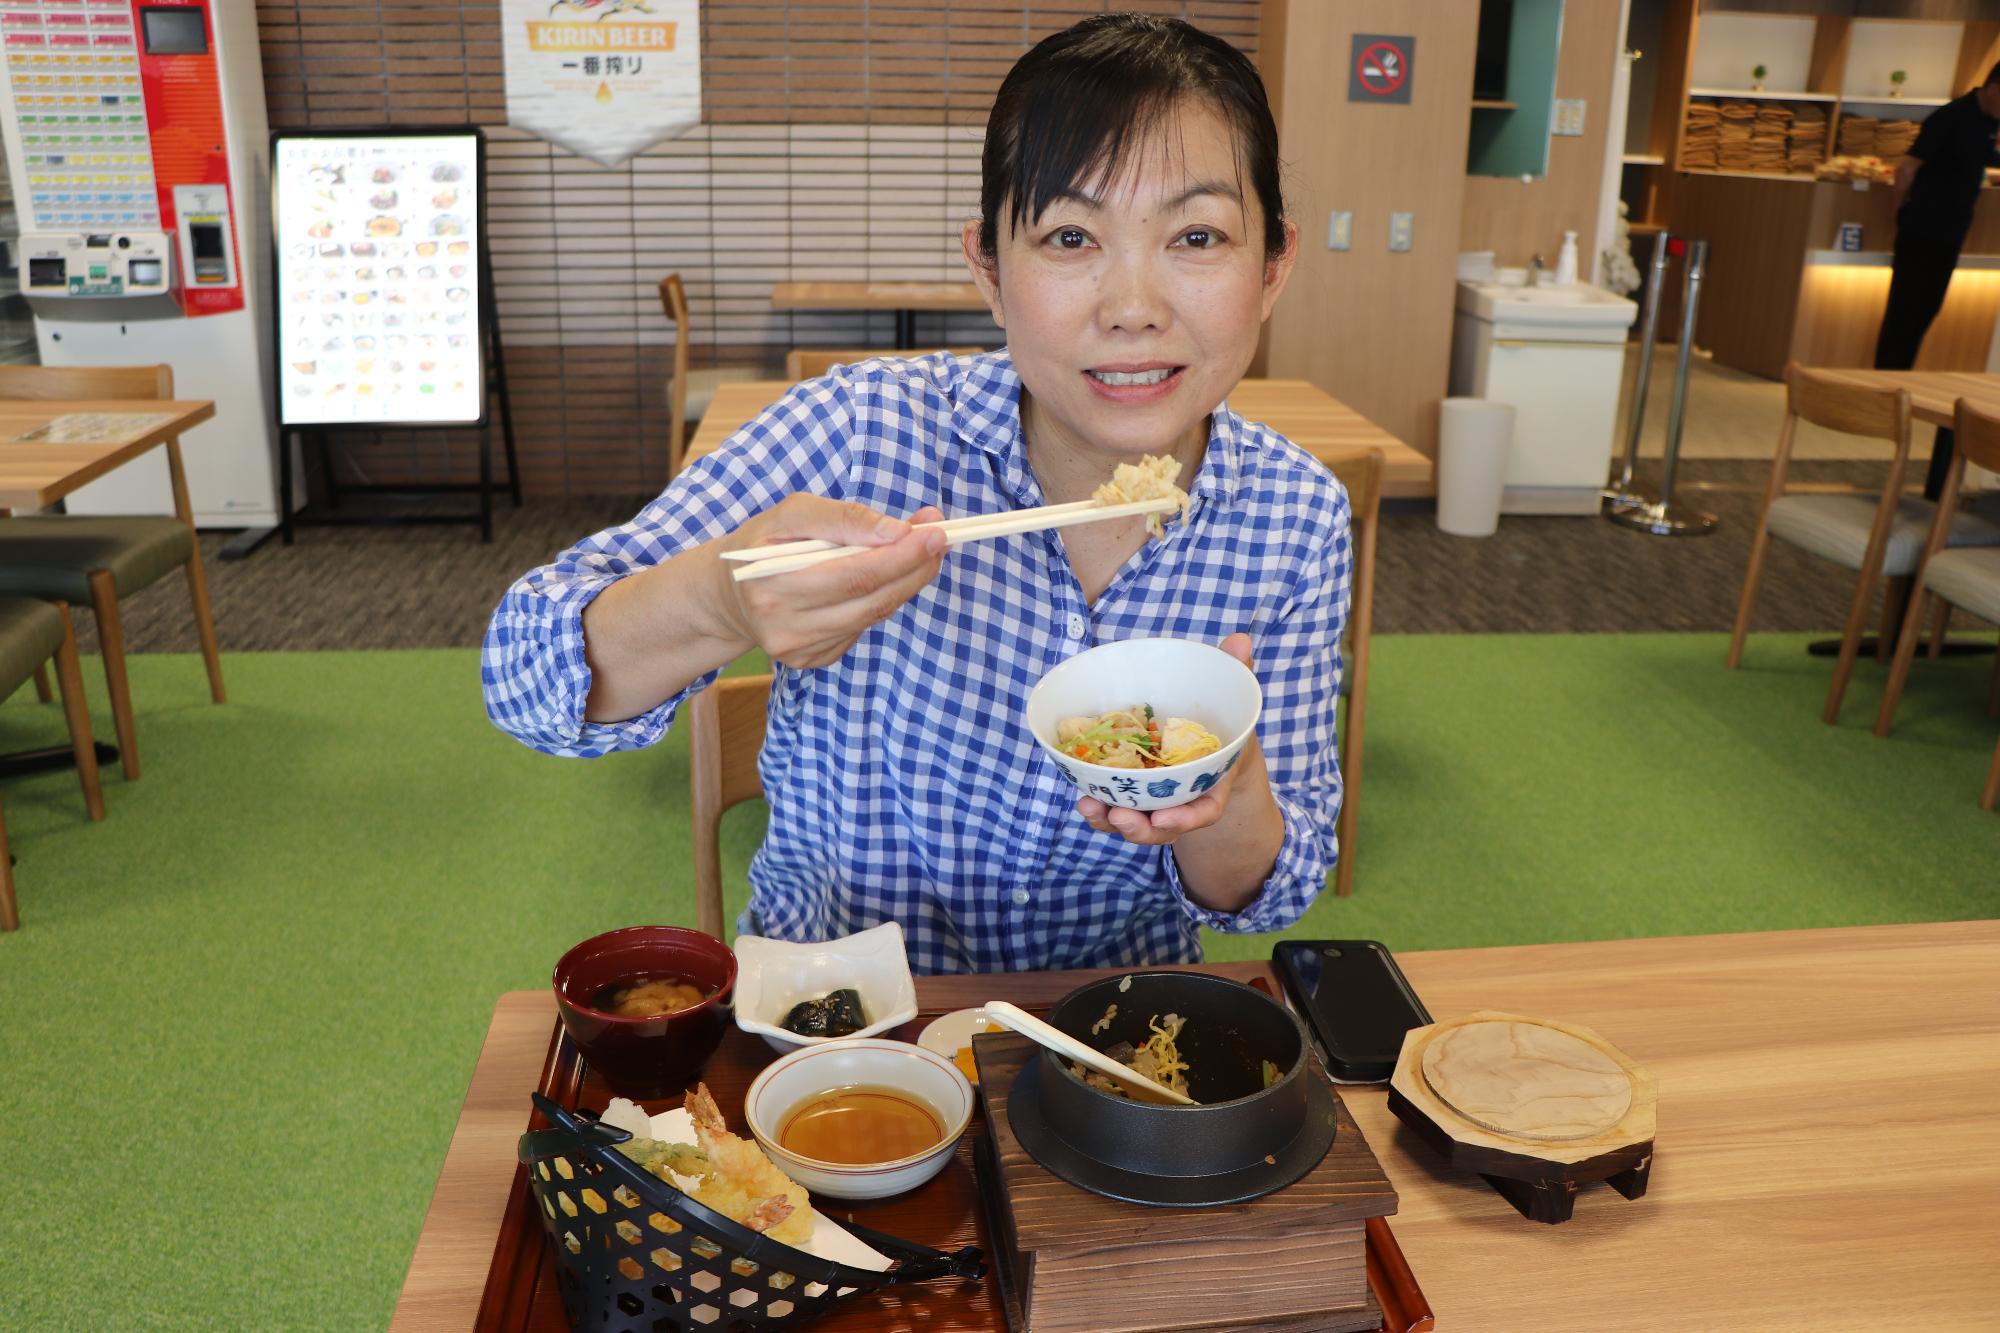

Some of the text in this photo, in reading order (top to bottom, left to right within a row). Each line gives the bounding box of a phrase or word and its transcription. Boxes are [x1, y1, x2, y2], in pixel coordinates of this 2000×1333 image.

[537, 26, 667, 47] KIRIN BEER
[561, 55, 643, 76] 一番搾り
